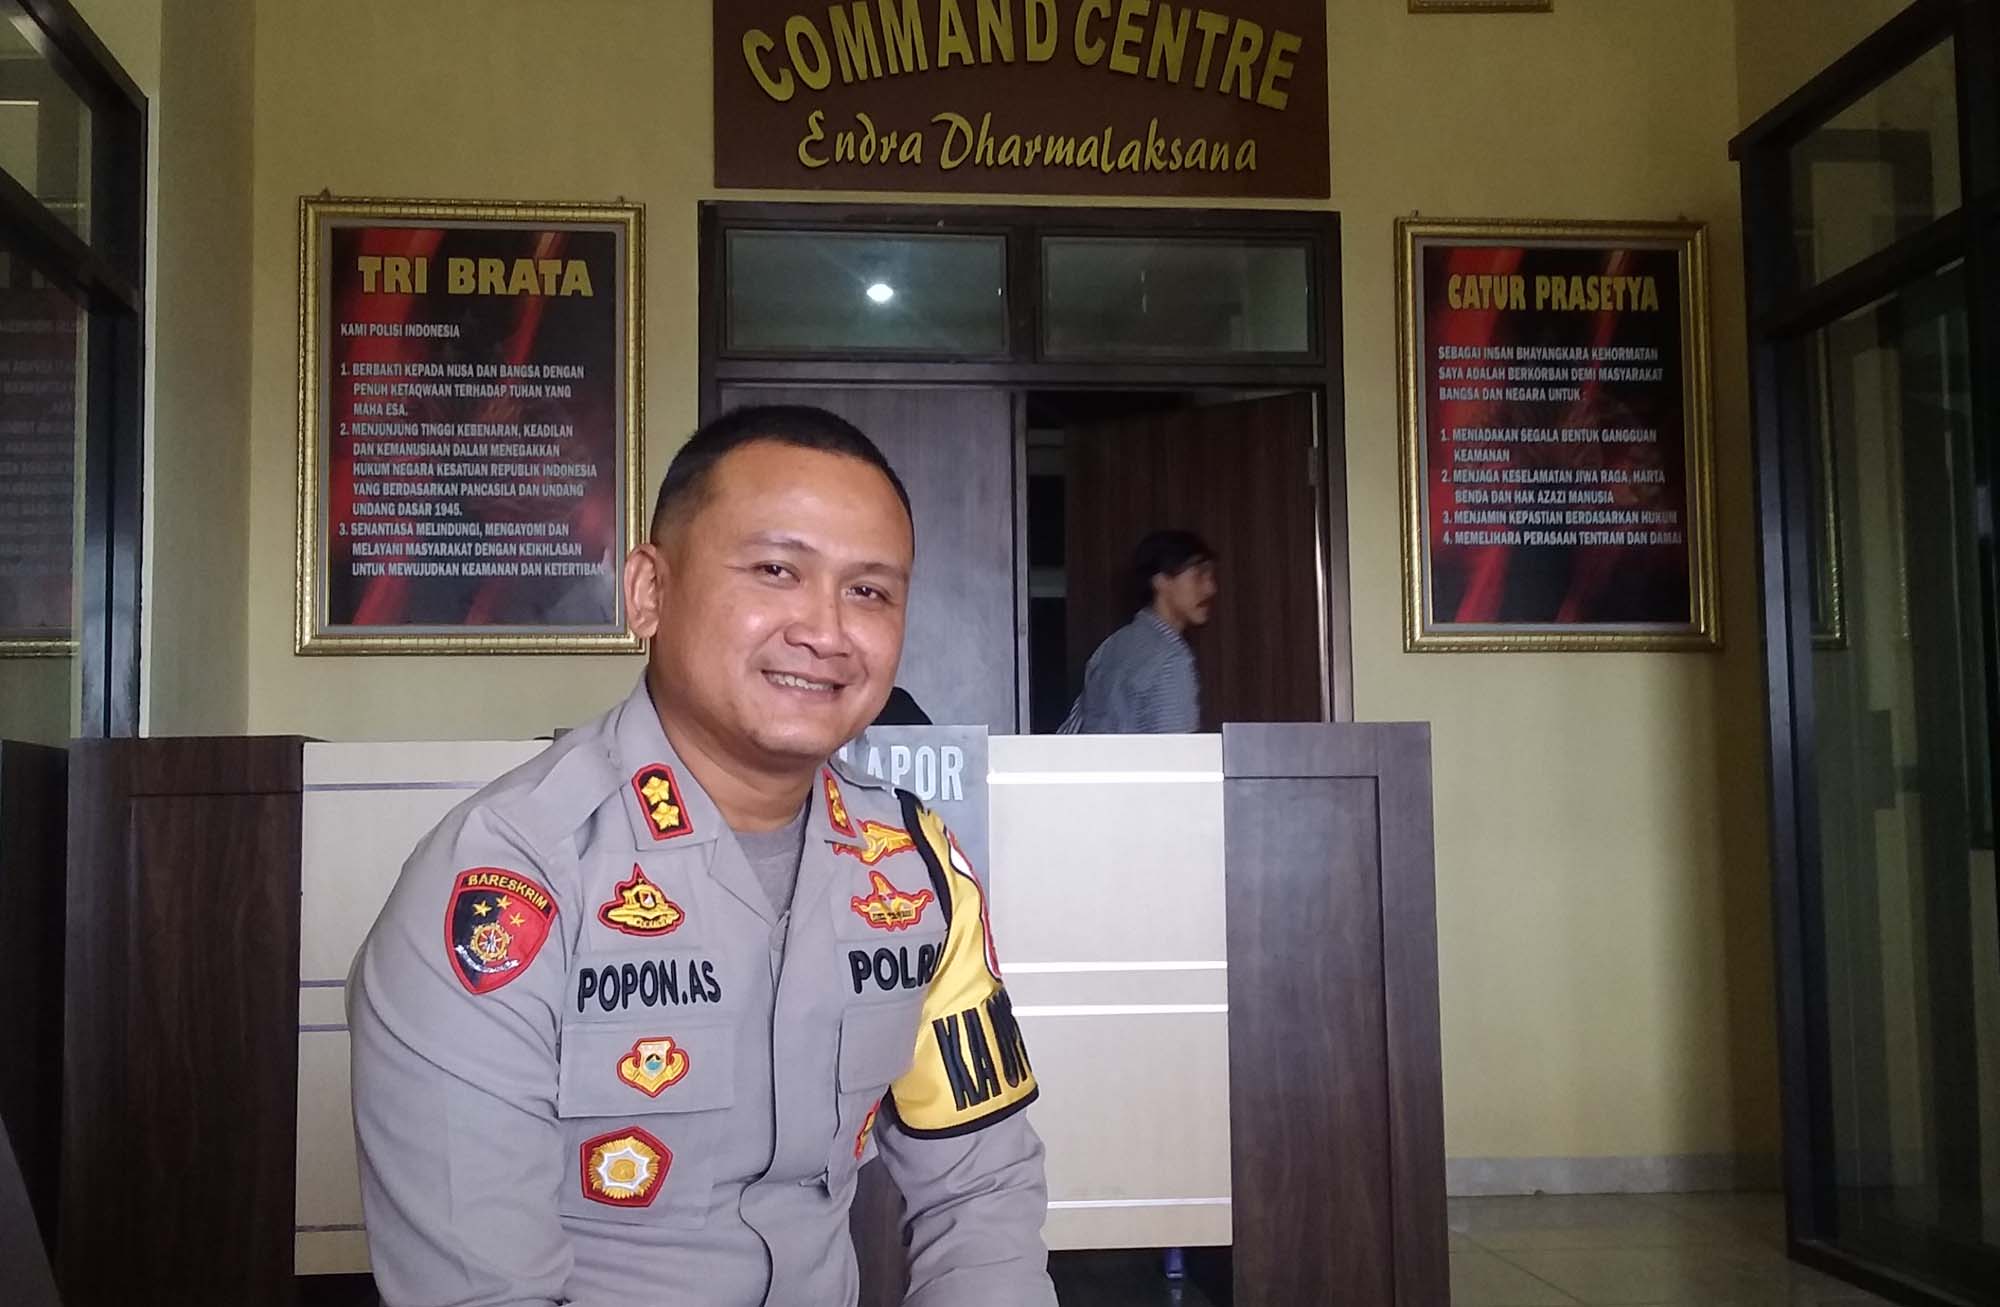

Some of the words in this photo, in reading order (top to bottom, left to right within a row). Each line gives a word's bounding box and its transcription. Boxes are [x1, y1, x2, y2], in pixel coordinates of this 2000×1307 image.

[741, 0, 1058, 101] COMMAND
[1074, 0, 1301, 110] CENTRE
[799, 110, 922, 168] Endra
[358, 256, 427, 293] TRI
[448, 258, 593, 296] BRATA
[1448, 274, 1527, 311] CATUR
[1535, 275, 1659, 312] PRASETYA
[341, 323, 367, 337] KAMI
[370, 324, 402, 337] POLISI
[405, 324, 460, 338] INDONESIA
[1438, 346, 1481, 360] SEBAGAI
[1484, 347, 1514, 360] INSAN
[1516, 347, 1589, 361] BHAYANGKARA
[1592, 347, 1658, 361] KEHORMATAN
[341, 363, 350, 376] 1.
[353, 363, 402, 376] BERBAKTI
[405, 363, 444, 376] KEPADA
[448, 364, 474, 376] NUSA
[477, 364, 498, 377] DAN
[500, 364, 541, 377] BANGSA
[543, 364, 584, 377] DENGAN
[1439, 367, 1463, 380] SAYA
[1466, 367, 1505, 380] ADALAH
[1508, 367, 1569, 381] BERKORBAN
[1571, 368, 1596, 381] DEMI
[1599, 368, 1664, 381] MASYARAKAT
[354, 383, 388, 396] PENUH
[391, 383, 452, 397] KETAQWAAN
[455, 384, 507, 397] TERHADAP
[510, 384, 542, 397] TUHAN
[546, 384, 572, 398] YANG
[1440, 388, 1481, 400] BANGSA
[1483, 388, 1503, 400] DAN
[1506, 388, 1546, 400] NEGARA
[1549, 388, 1580, 401] UNTUK
[354, 404, 384, 416] MAHA
[386, 404, 408, 416] ESA.
[340, 423, 349, 436] 2.
[352, 424, 418, 436] MENJUNJUNG
[422, 424, 454, 437] TINGGI
[457, 424, 521, 437] KEBENARAN,
[524, 424, 573, 437] KEADILAN
[1441, 429, 1450, 442] 1.
[1453, 429, 1518, 442] MENIADAKAN
[1521, 429, 1559, 442] SEGALA
[1562, 429, 1599, 442] BENTUK
[1602, 429, 1656, 442] GANGGUAN
[353, 444, 374, 456] DAN
[377, 444, 450, 456] KEMANUSIAAN
[453, 444, 488, 457] DALAM
[490, 444, 560, 457] MENEGAKKAN
[1454, 449, 1510, 462] KEAMANAN
[353, 463, 390, 476] HUKUM
[393, 463, 434, 476] NEGARA
[437, 463, 488, 477] KESATUAN
[490, 464, 540, 477] REPUBLIK
[543, 464, 597, 477] INDONESIA
[1442, 470, 1451, 483] 2.
[1454, 470, 1499, 483] MENJAGA
[1502, 470, 1572, 483] KESELAMATAN
[1574, 470, 1598, 483] JIWA
[1633, 470, 1665, 483] HARTA
[353, 483, 380, 496] YANG
[383, 483, 458, 496] BERDASARKAN
[461, 484, 516, 496] PANCASILA
[518, 484, 540, 496] DAN
[542, 484, 584, 497] UNDANG
[1455, 491, 1488, 503] BENDA
[1491, 491, 1512, 503] DAN
[1514, 491, 1535, 503] HAK
[1538, 491, 1566, 503] AZAZI
[1568, 491, 1614, 503] MANUSIA
[353, 503, 395, 516] UNDANG
[398, 503, 432, 516] DASAR
[435, 503, 462, 516] 1945.
[1443, 512, 1452, 524] 3.
[1454, 512, 1506, 524] MENJAMIN
[1509, 512, 1563, 524] KEPASTIAN
[1566, 512, 1639, 524] BERDASARKAN
[339, 523, 348, 536] 3.
[351, 524, 414, 536] SENANTIASA
[485, 524, 546, 537] MENGAYOMI
[548, 524, 569, 537] DAN
[1444, 532, 1453, 545] 4.
[1455, 532, 1521, 545] MEMELIHARA
[1524, 532, 1577, 545] PERASAAN
[1579, 532, 1624, 545] TENTRAM
[1627, 532, 1648, 545] DAN
[352, 544, 403, 556] MELAYANI
[406, 544, 472, 556] MASYARAKAT
[475, 544, 516, 556] DENGAN
[519, 544, 582, 557] KEIKHLASAN
[352, 563, 385, 576] UNTUK
[388, 563, 459, 576] MEWUJUDKAN
[462, 563, 518, 576] KEAMANAN
[521, 563, 542, 576] DAN
[468, 874, 548, 911] BARESKRIM
[578, 959, 722, 1013] POPON.AS
